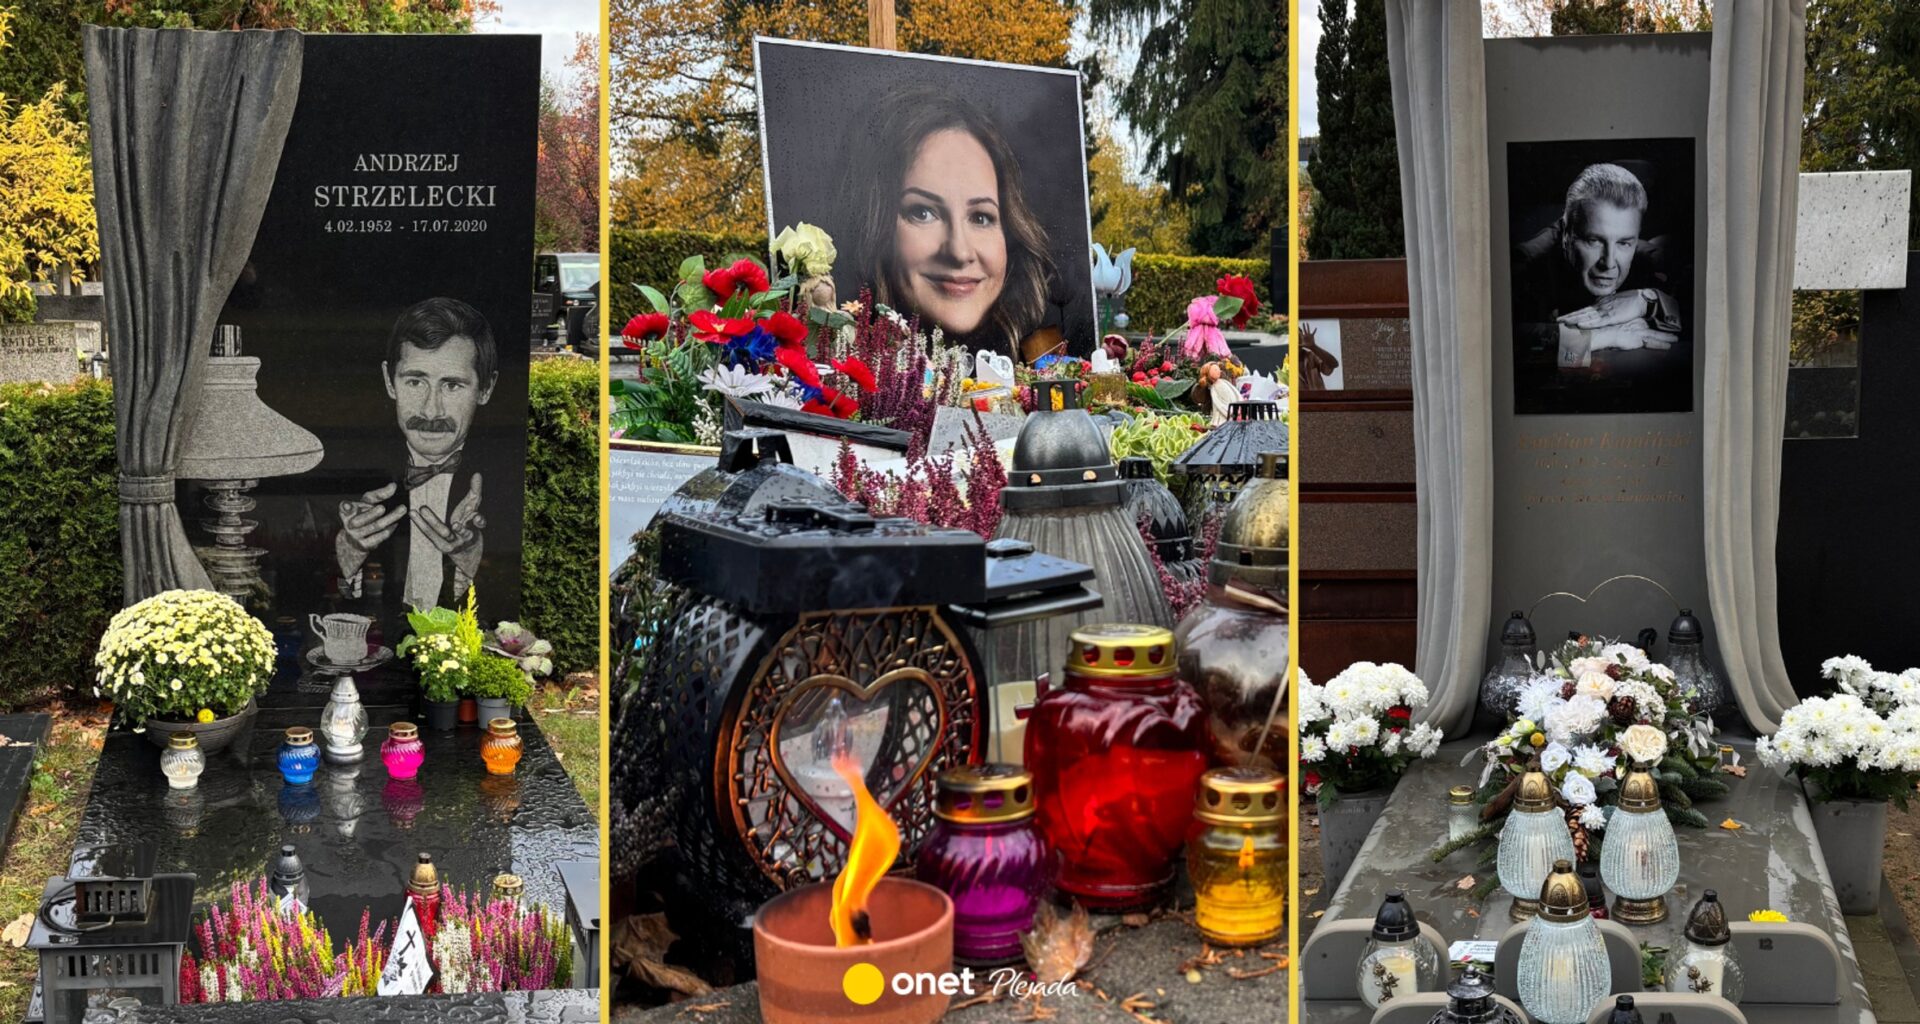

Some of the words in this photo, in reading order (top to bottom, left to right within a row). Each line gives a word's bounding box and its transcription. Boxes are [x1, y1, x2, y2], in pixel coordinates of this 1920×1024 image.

[353, 154, 460, 172] ANDRZEJ
[314, 185, 497, 208] STRZELECKI
[324, 219, 392, 233] 4.02.1952
[412, 219, 488, 233] 17.07.2020
